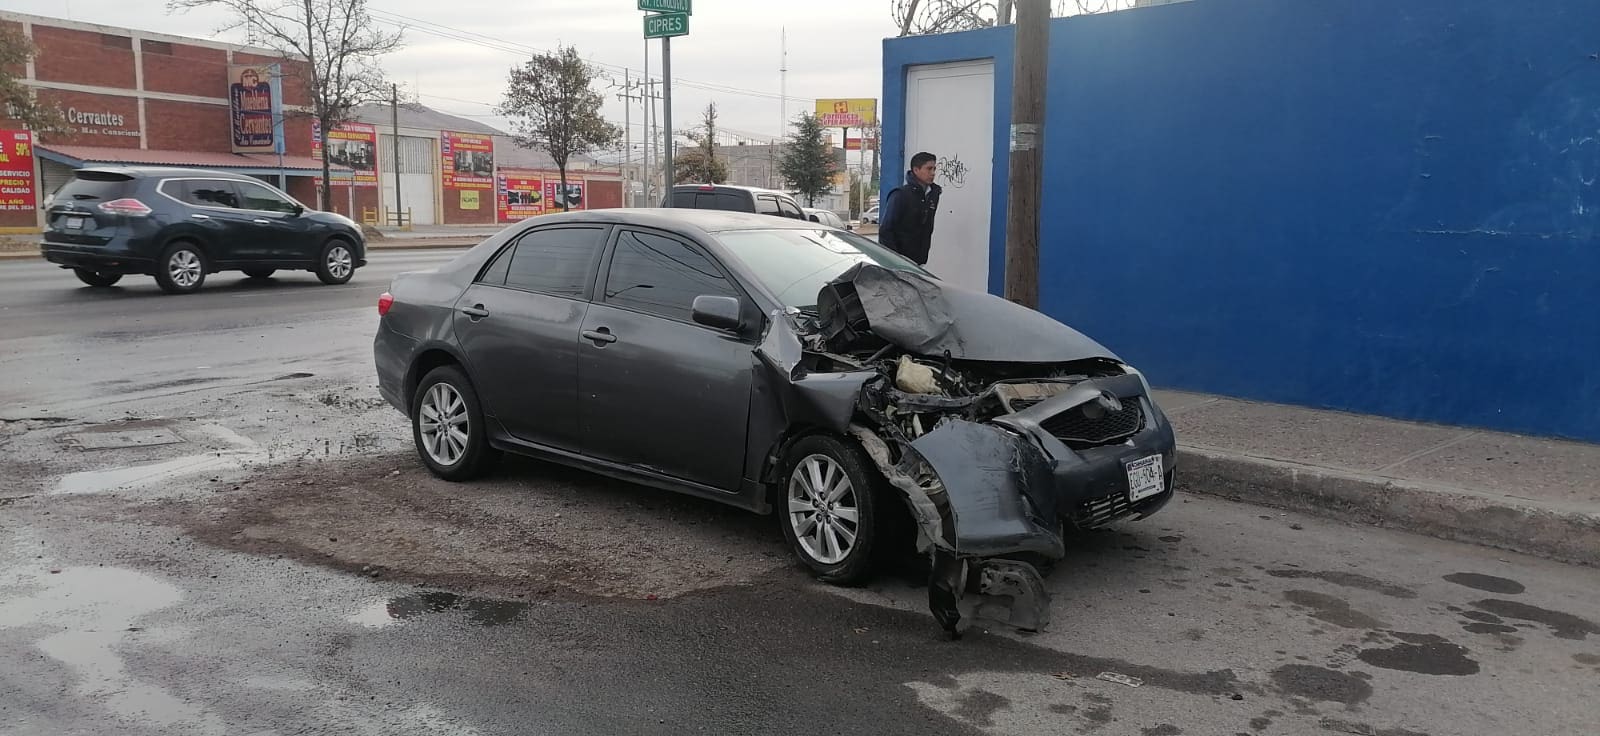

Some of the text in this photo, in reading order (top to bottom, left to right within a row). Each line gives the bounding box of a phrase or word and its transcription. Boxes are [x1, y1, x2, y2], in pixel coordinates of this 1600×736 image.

[649, 17, 682, 33] CIPRES
[68, 107, 124, 127] Cervantes
[240, 113, 272, 135] Cervantes
[81, 126, 98, 134] Mas
[15, 142, 31, 157] 50%
